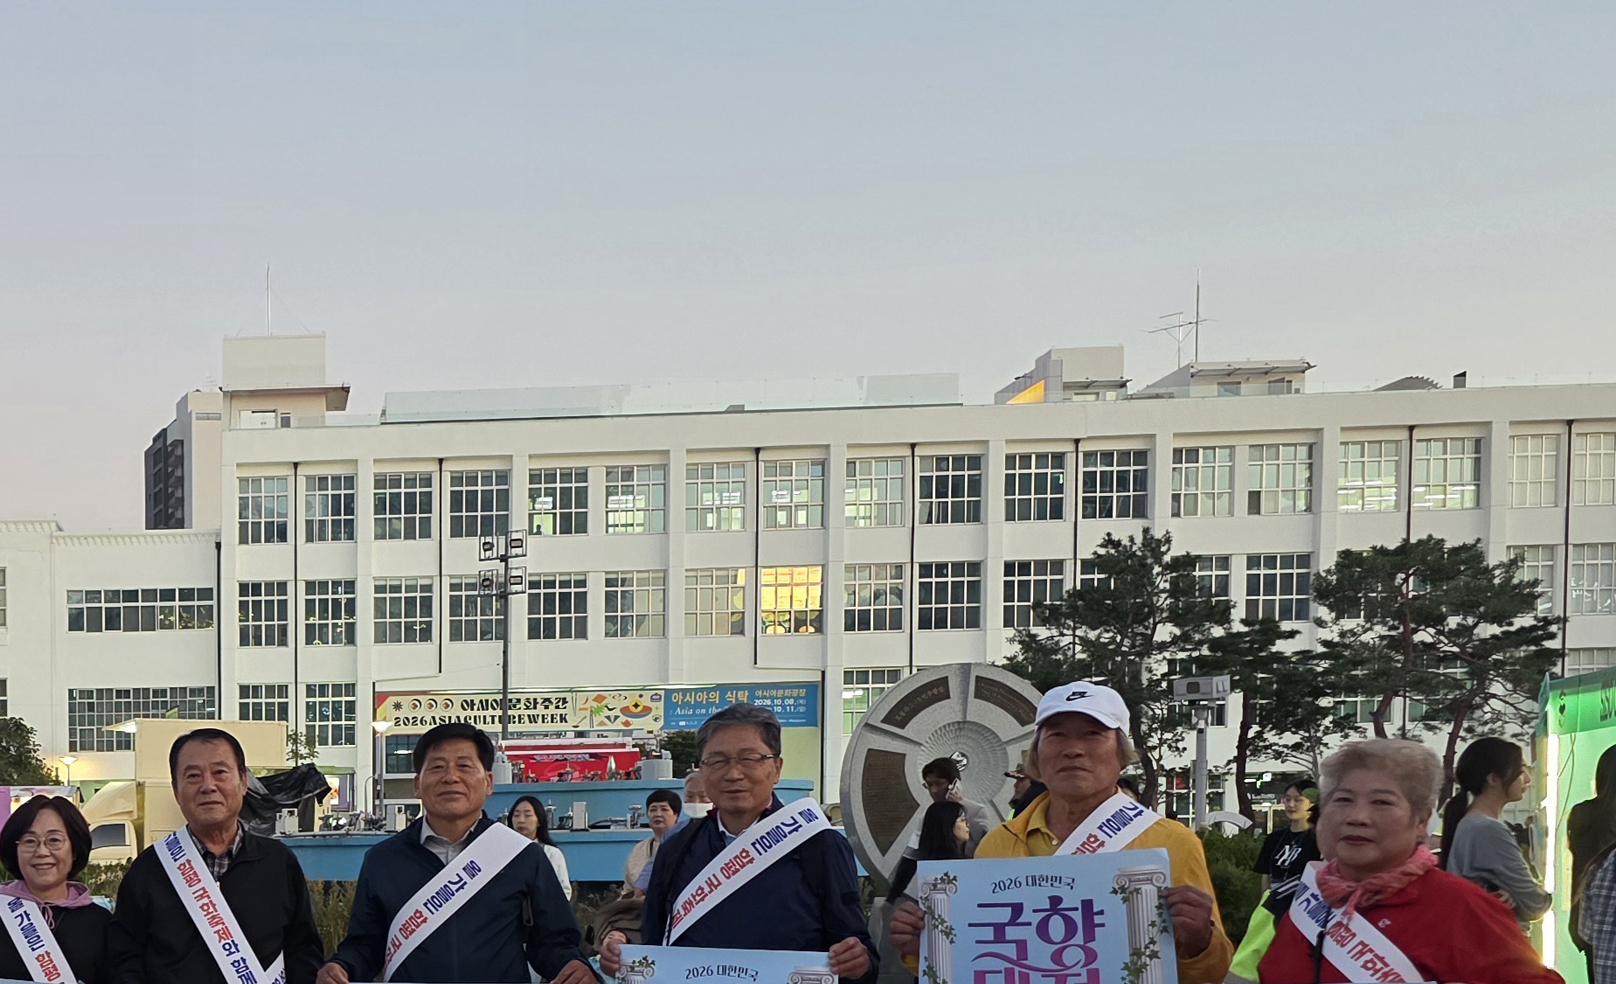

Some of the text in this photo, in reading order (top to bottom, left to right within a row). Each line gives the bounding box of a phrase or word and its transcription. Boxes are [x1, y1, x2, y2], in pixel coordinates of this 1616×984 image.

[671, 690, 720, 705] 아시아의
[797, 808, 819, 825] 올
[750, 816, 803, 856] 가을은
[461, 860, 482, 880] 올
[719, 848, 755, 880] 함평
[422, 873, 468, 915] 가을은
[991, 874, 1076, 894] 2026 대한민국
[177, 858, 202, 888] 함평
[192, 886, 241, 957] 국화축제와
[398, 908, 429, 940] 함평
[967, 895, 1106, 973] 국향
[13, 910, 46, 952] 가을은
[34, 949, 61, 984] 함평
[685, 964, 759, 982] 2026 대한민국
